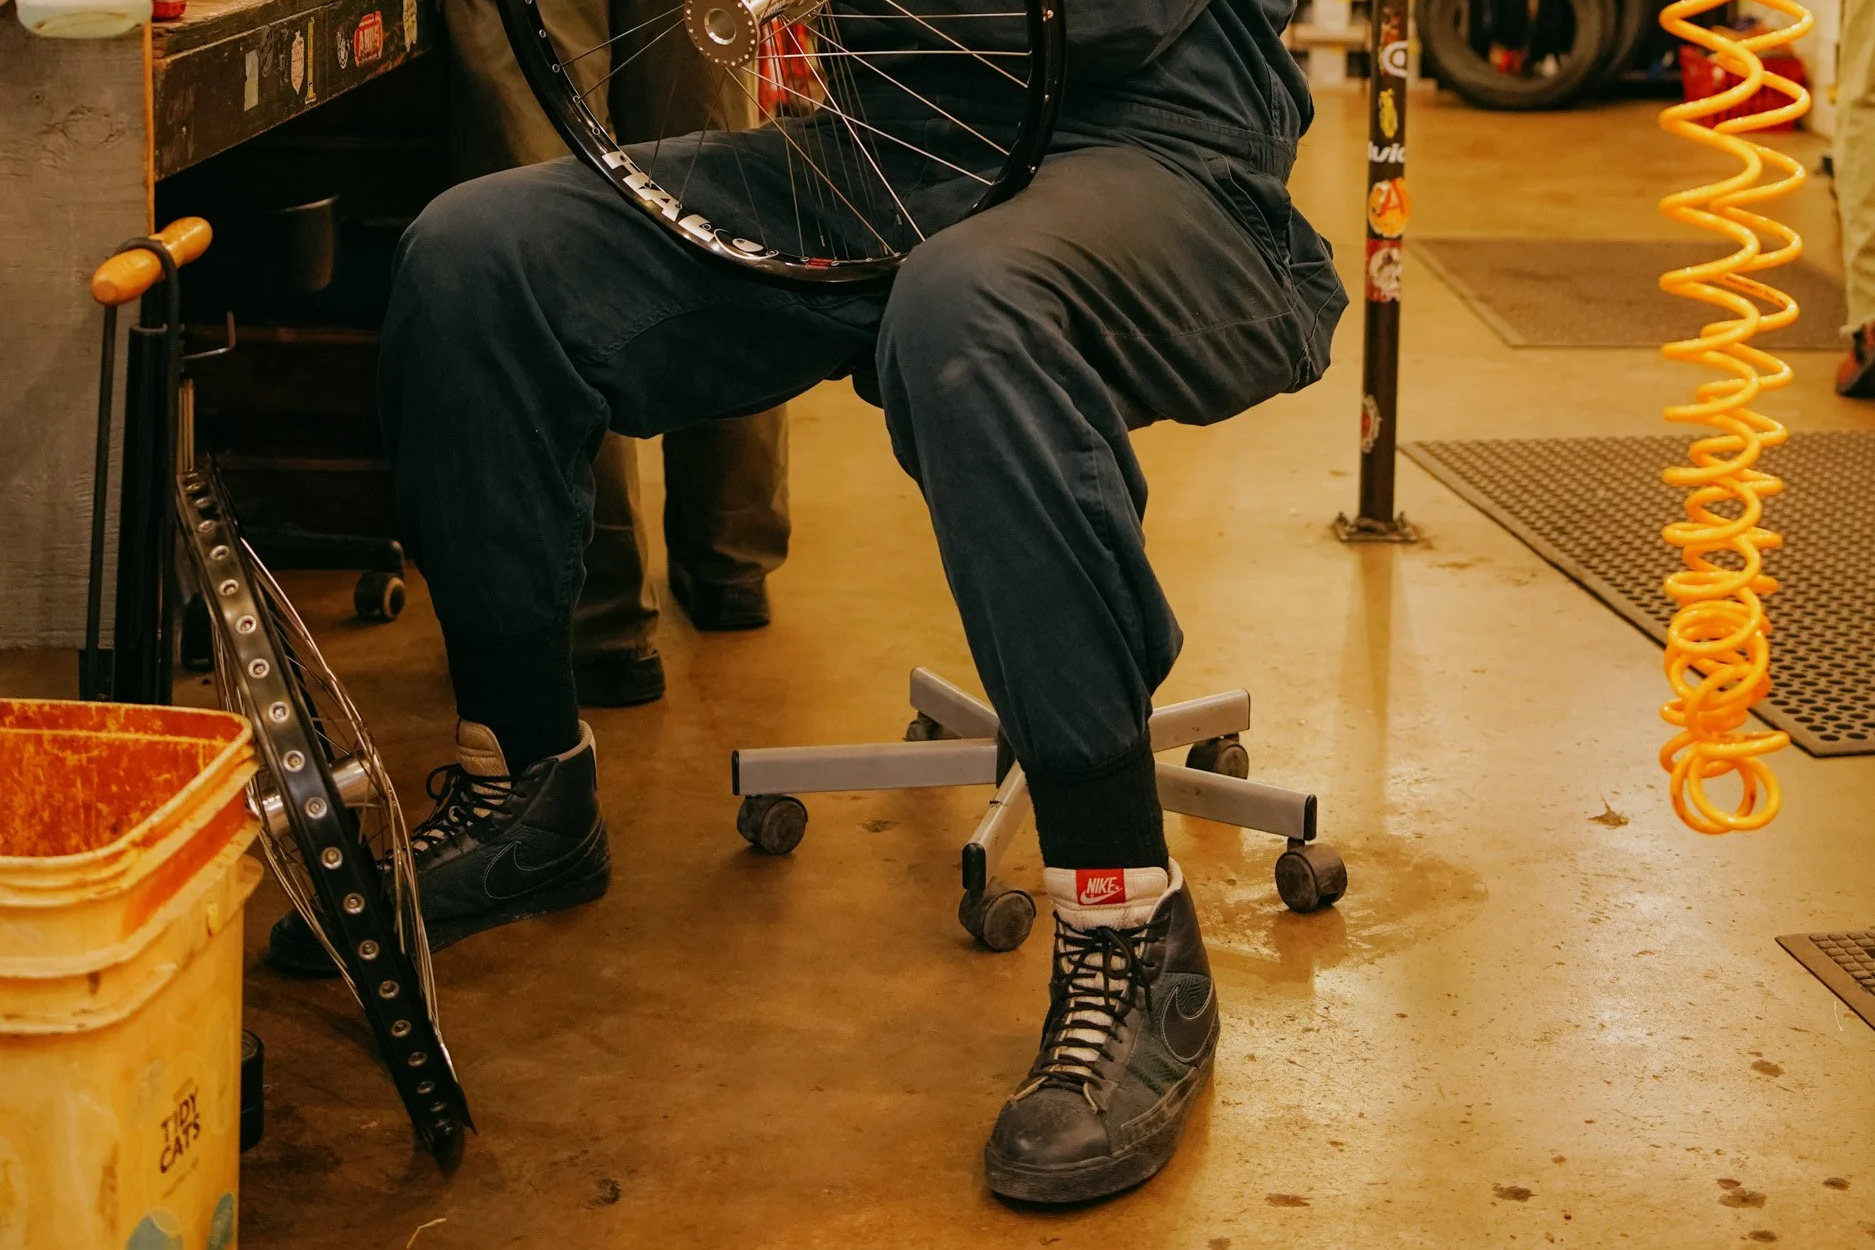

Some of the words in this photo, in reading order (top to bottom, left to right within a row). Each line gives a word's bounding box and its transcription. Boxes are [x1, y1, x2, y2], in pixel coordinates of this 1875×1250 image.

[601, 150, 780, 261] HALO
[1086, 876, 1118, 895] NIKE
[160, 1113, 201, 1174] CATS
[161, 1085, 200, 1143] TIDY
